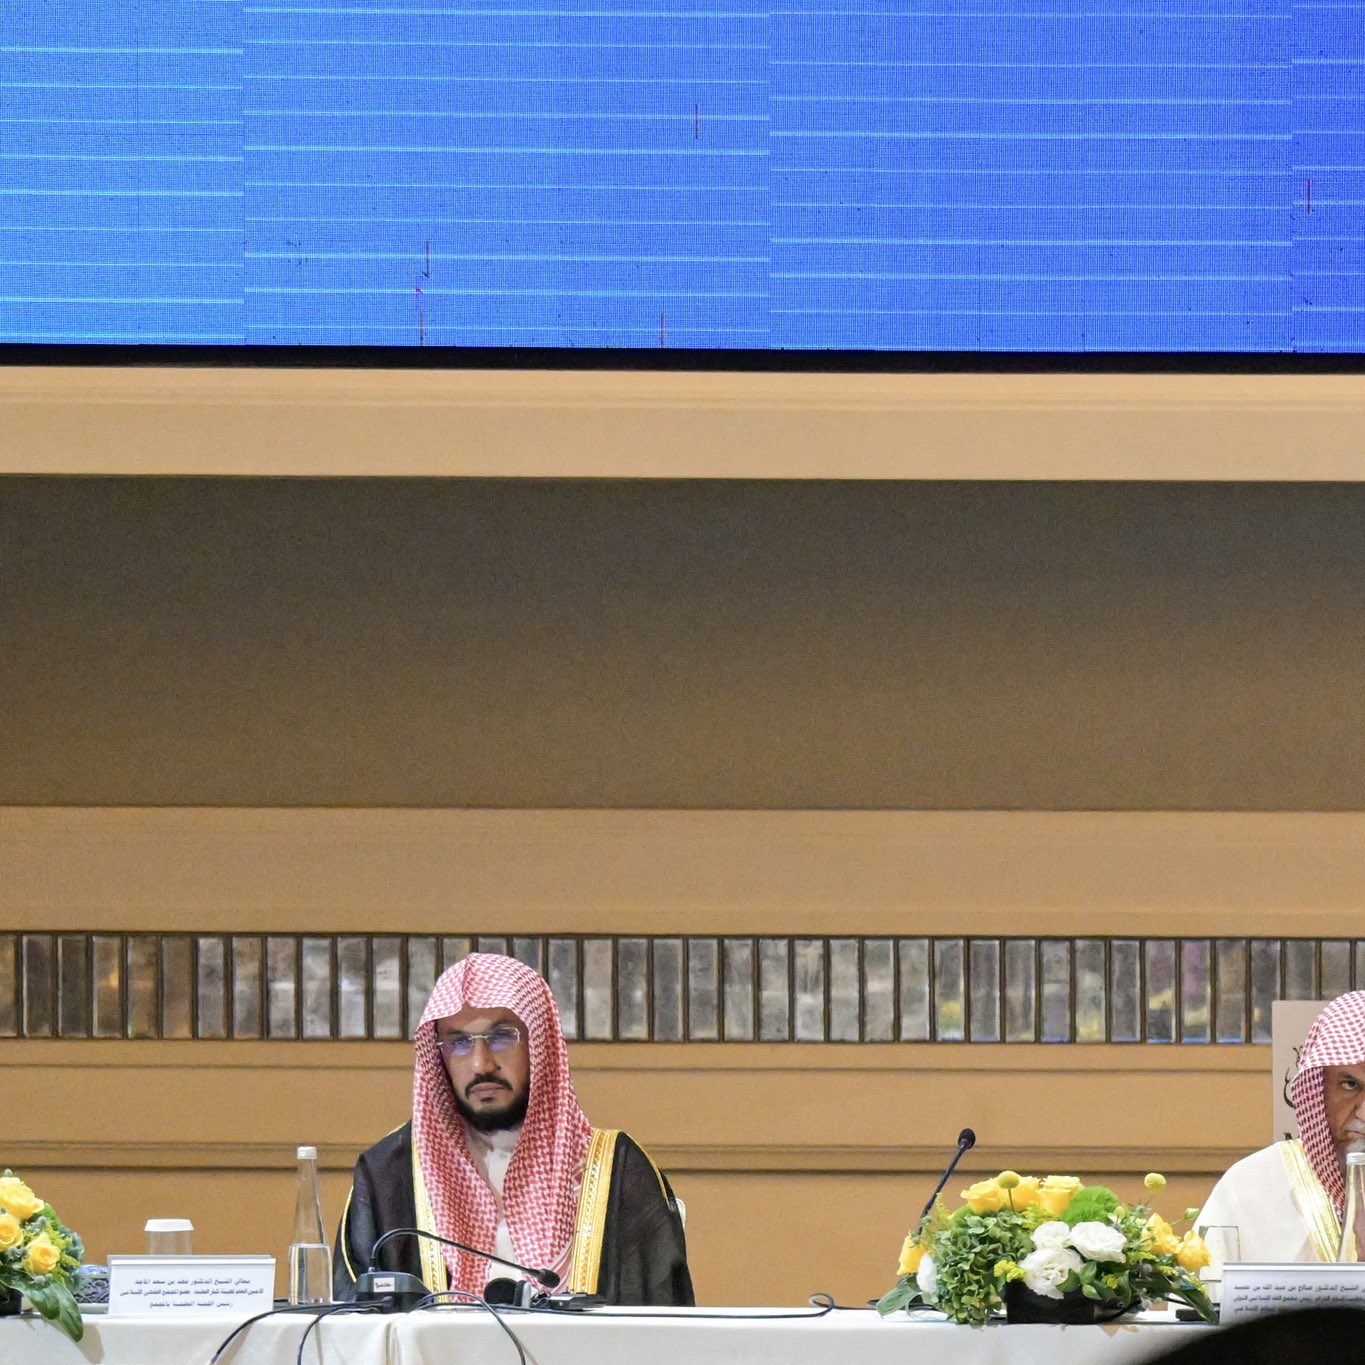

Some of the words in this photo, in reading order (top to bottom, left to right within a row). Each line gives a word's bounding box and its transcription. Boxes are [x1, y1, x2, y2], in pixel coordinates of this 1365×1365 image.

[190, 1278, 213, 1286] الدكتور
[214, 1278, 232, 1286] الشيخ
[1339, 1284, 1359, 1293] الشيخ
